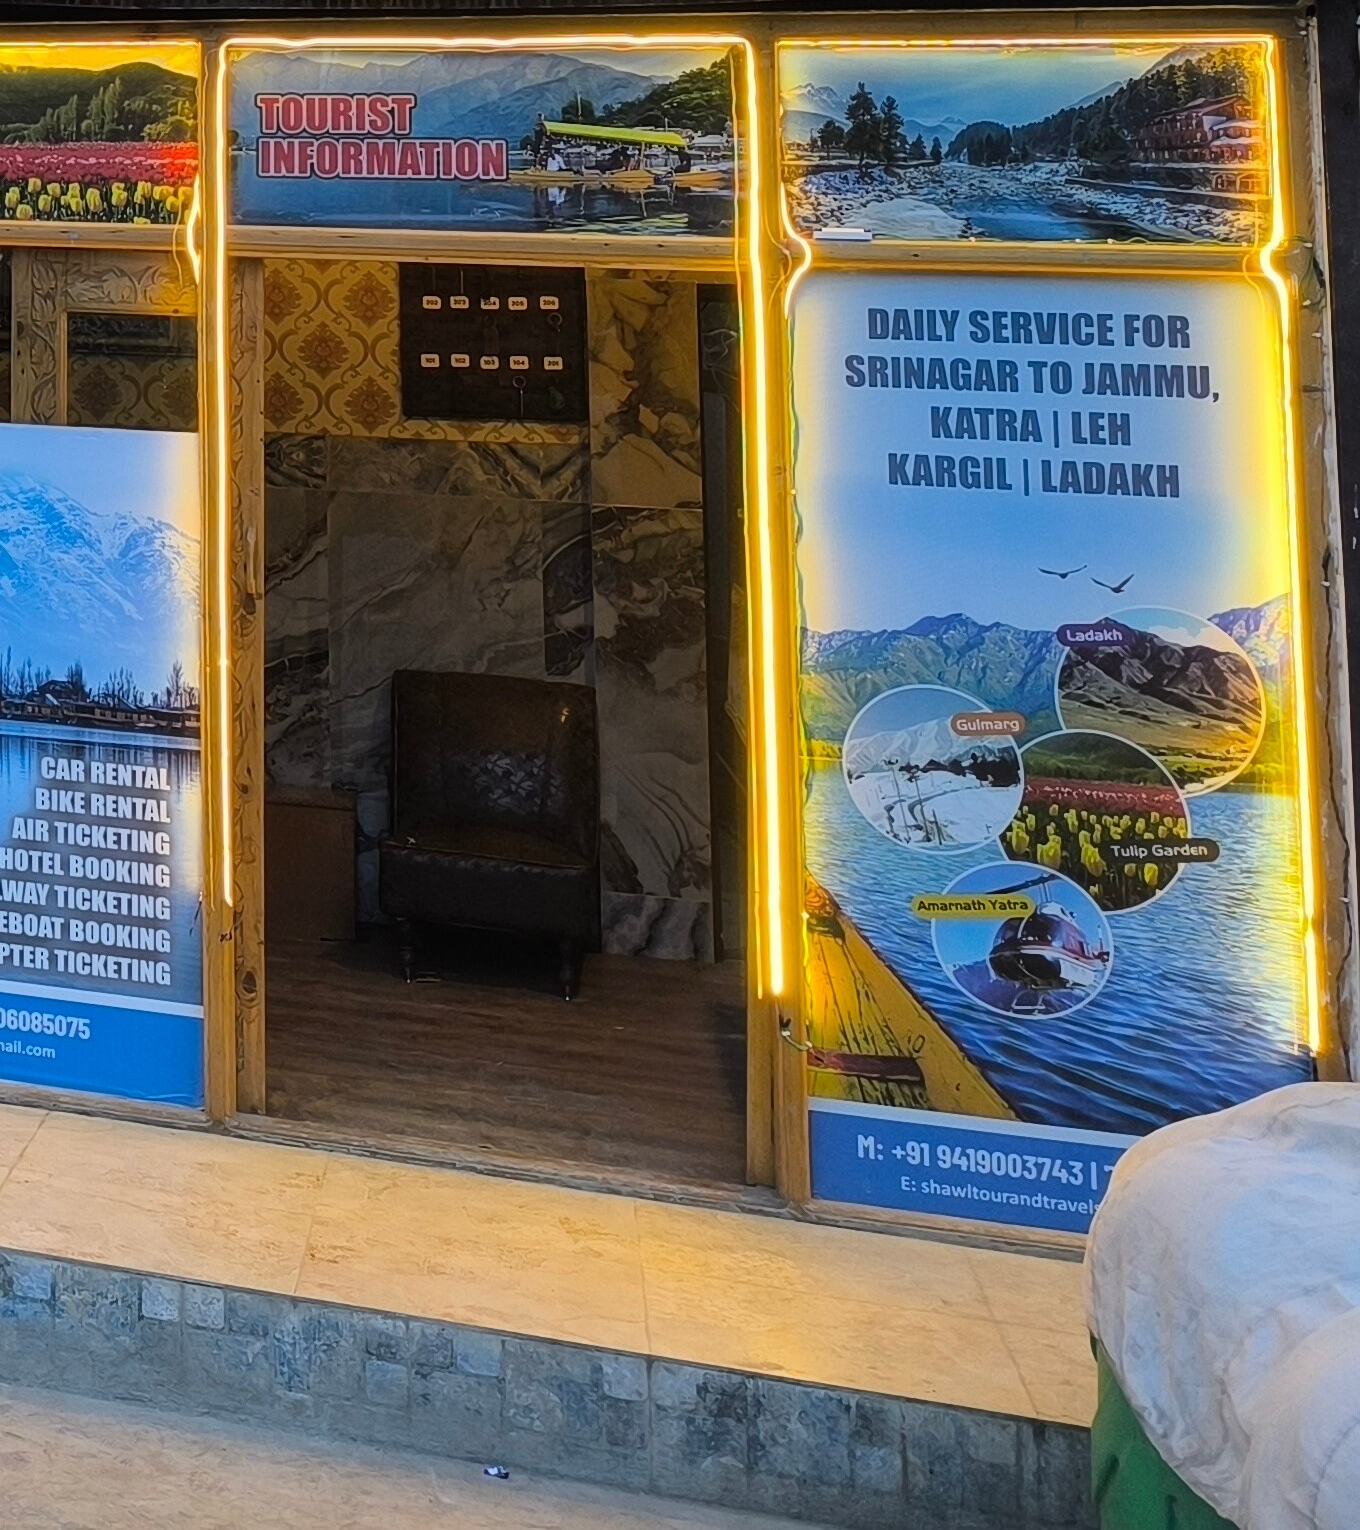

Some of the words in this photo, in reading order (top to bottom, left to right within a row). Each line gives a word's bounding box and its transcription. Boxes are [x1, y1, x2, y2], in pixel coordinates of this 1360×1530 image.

[256, 93, 415, 134] TOURIST
[257, 138, 509, 180] INFORMATION
[867, 308, 959, 341] DAILY
[969, 310, 1113, 346] SERVICE
[1124, 314, 1190, 348] FOR
[845, 355, 1019, 392] SRINAGAR
[1027, 361, 1072, 394] TO
[1083, 363, 1219, 402] JAMMU,
[930, 406, 1042, 442] KATRA
[1071, 412, 1131, 446] LEH
[888, 453, 1012, 490] KARGIL
[1041, 459, 1180, 498] LADAKH
[1066, 628, 1122, 642] Ladakh
[956, 718, 1020, 733] Gulmarg
[41, 757, 85, 782] CAR
[90, 761, 170, 791] RENTAL
[36, 788, 85, 814] BIKE
[90, 792, 170, 823] RENTAL
[12, 818, 49, 841] AIR
[54, 821, 170, 855] TICKETING
[1110, 844, 1146, 859] Tulip
[1152, 844, 1208, 857] Garden
[0, 848, 64, 876] HOTEL
[69, 856, 170, 887] BOOKING
[54, 884, 170, 920] TICKETING
[917, 898, 985, 912] Amarnath
[989, 898, 1028, 912] Yatra
[69, 918, 170, 953] BOOKING
[54, 948, 170, 986] TICKETING
[857, 1135, 883, 1160] M:
[892, 1141, 930, 1166] +91
[937, 1145, 1083, 1185] 9419003743
[901, 1176, 916, 1191] E:
